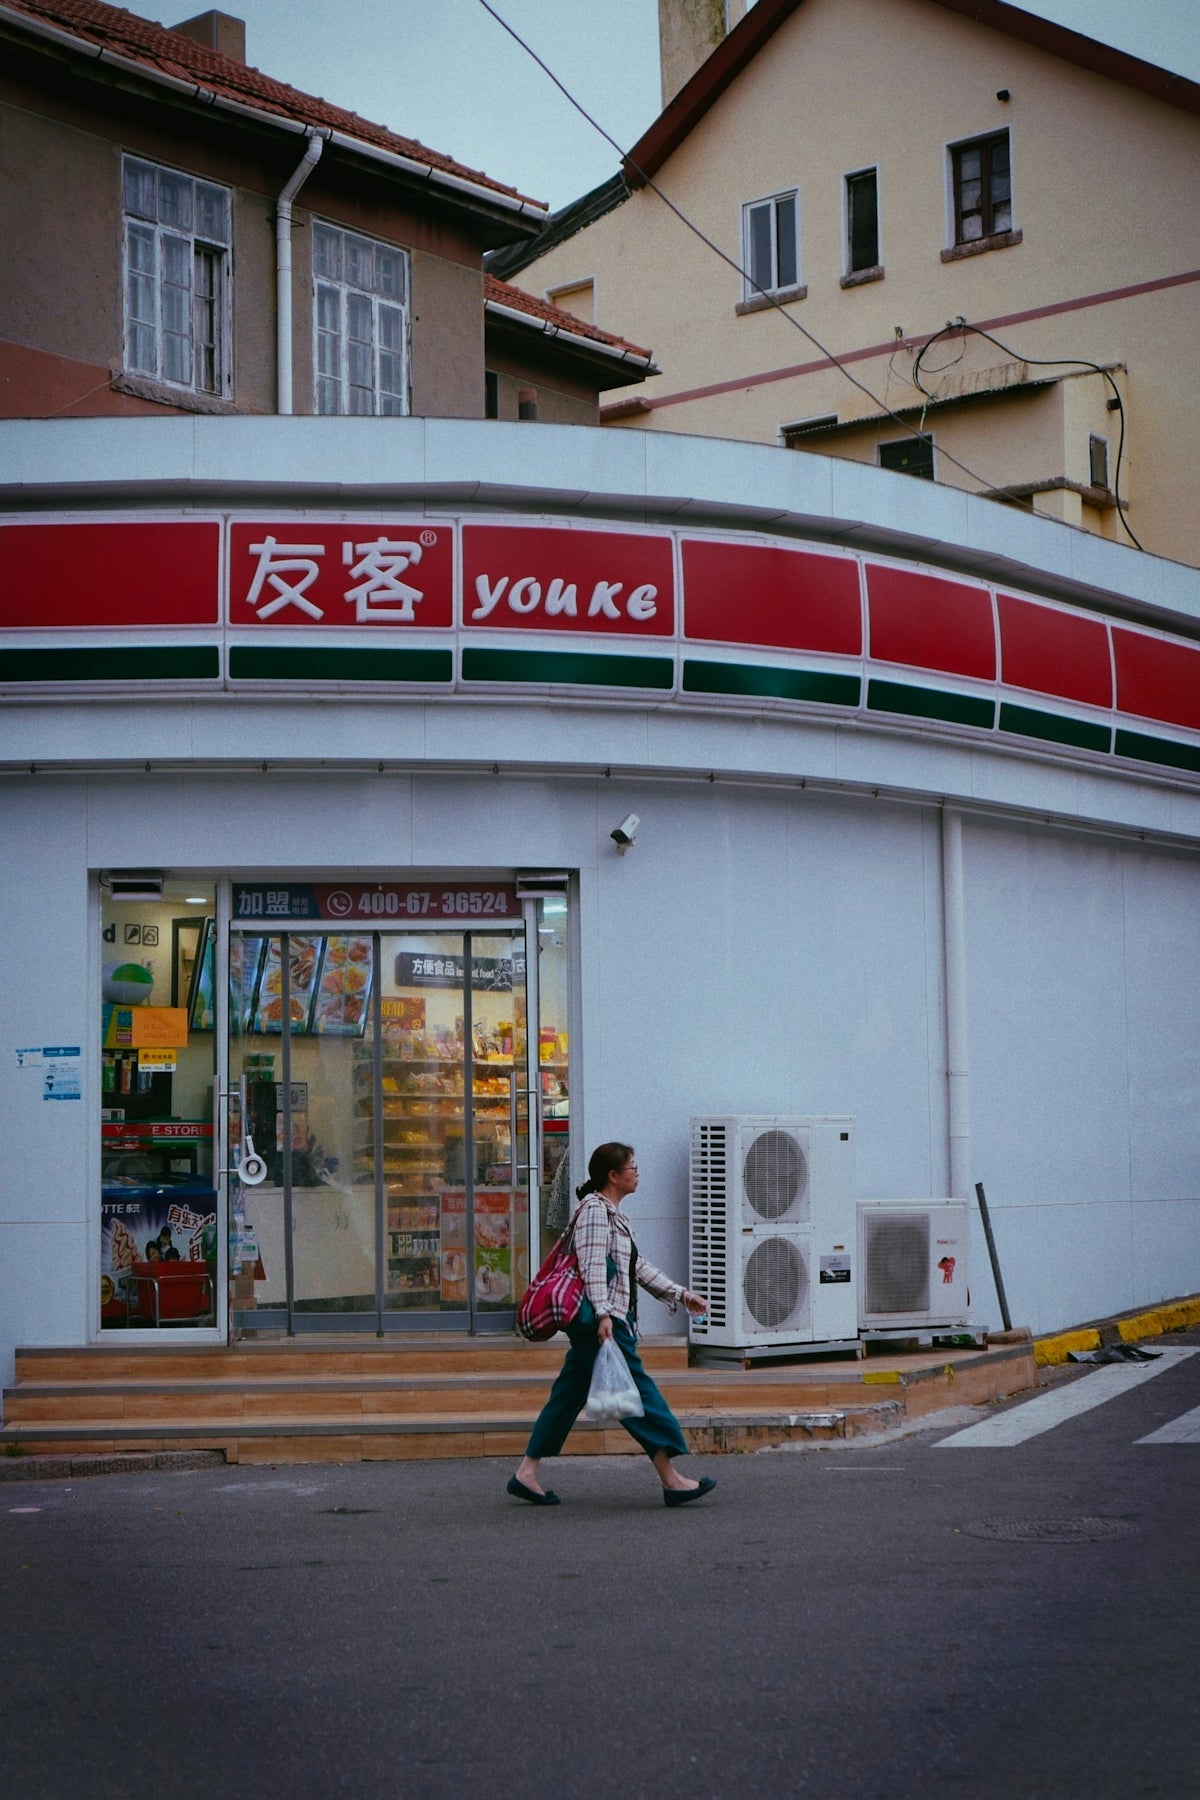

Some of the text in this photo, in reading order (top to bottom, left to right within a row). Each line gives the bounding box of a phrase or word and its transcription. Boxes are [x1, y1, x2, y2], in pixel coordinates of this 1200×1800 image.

[246, 535, 424, 623] 友客
[238, 891, 290, 915] 加盟
[412, 959, 455, 976] 方便食品
[115, 1126, 206, 1135] YKE.STORE
